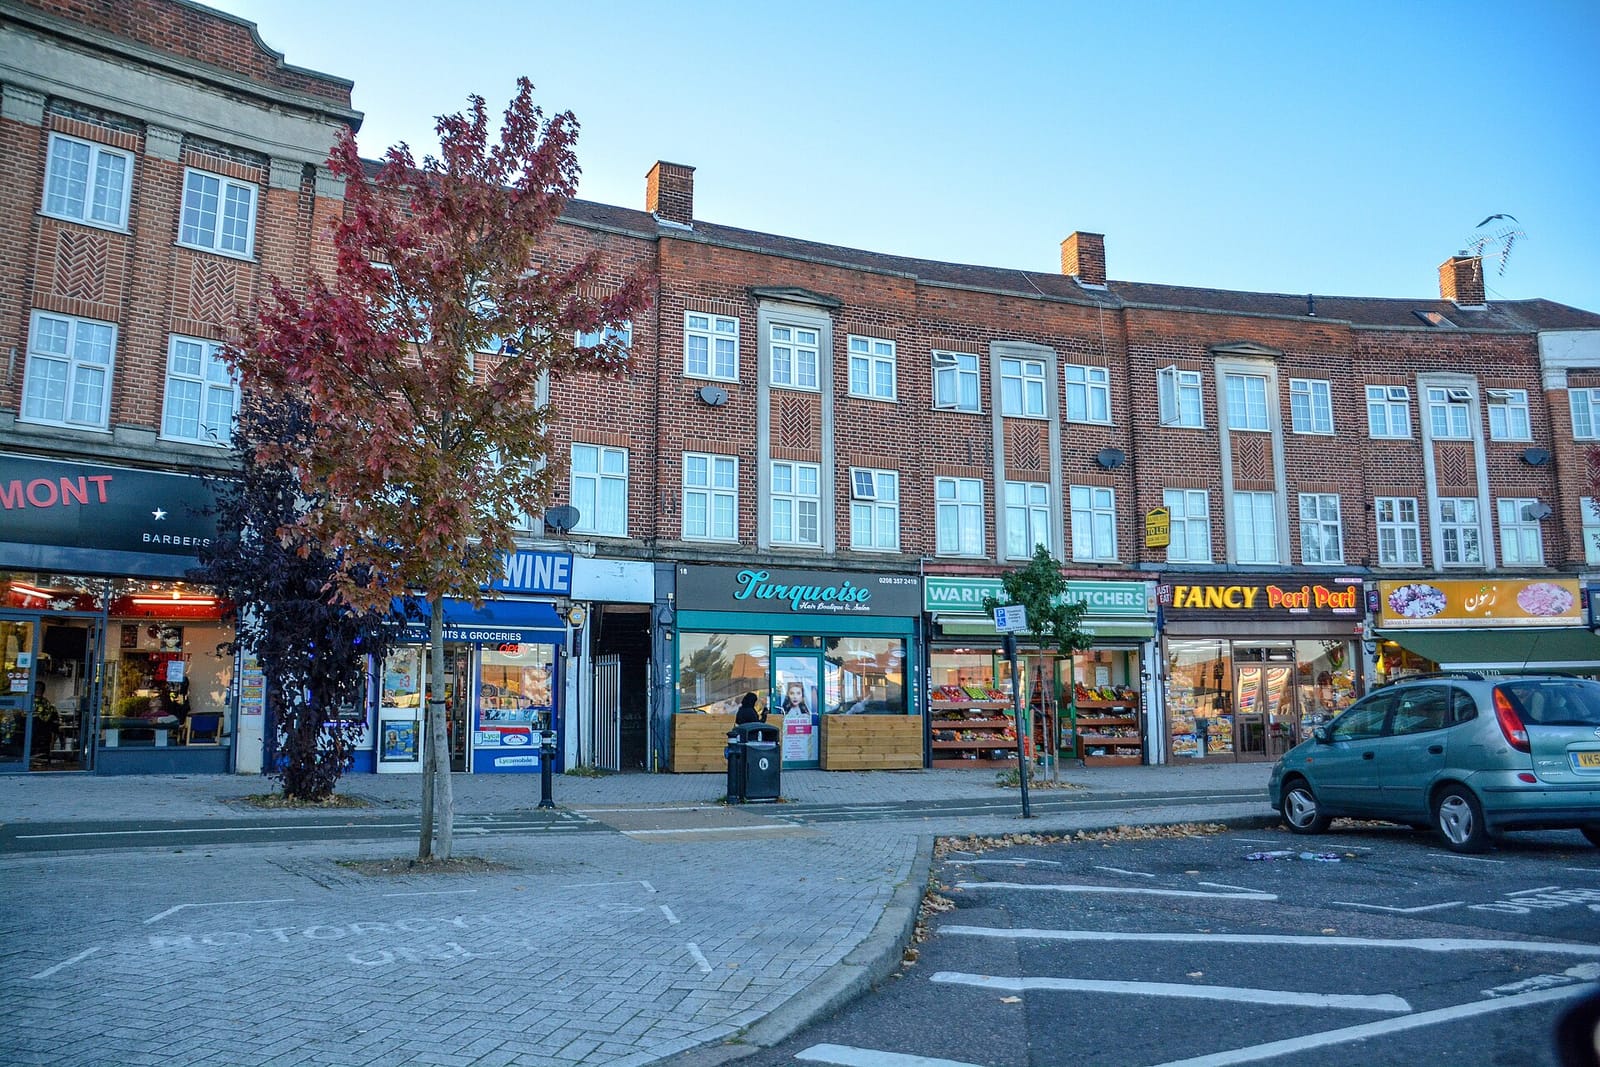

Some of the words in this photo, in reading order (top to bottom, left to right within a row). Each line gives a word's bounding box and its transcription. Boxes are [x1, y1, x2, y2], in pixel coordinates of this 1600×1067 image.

[502, 553, 569, 590] WINE
[735, 569, 871, 611] Turquoise
[928, 586, 990, 602] WARIS
[1060, 590, 1144, 606] BUTCHERS
[1156, 585, 1169, 596] JUST
[1172, 585, 1259, 609] FANCY
[1266, 584, 1310, 609] Peri
[1312, 584, 1356, 609] Peri
[1159, 594, 1170, 604] EAT
[460, 631, 467, 639] &
[469, 631, 522, 641] GROCERIES
